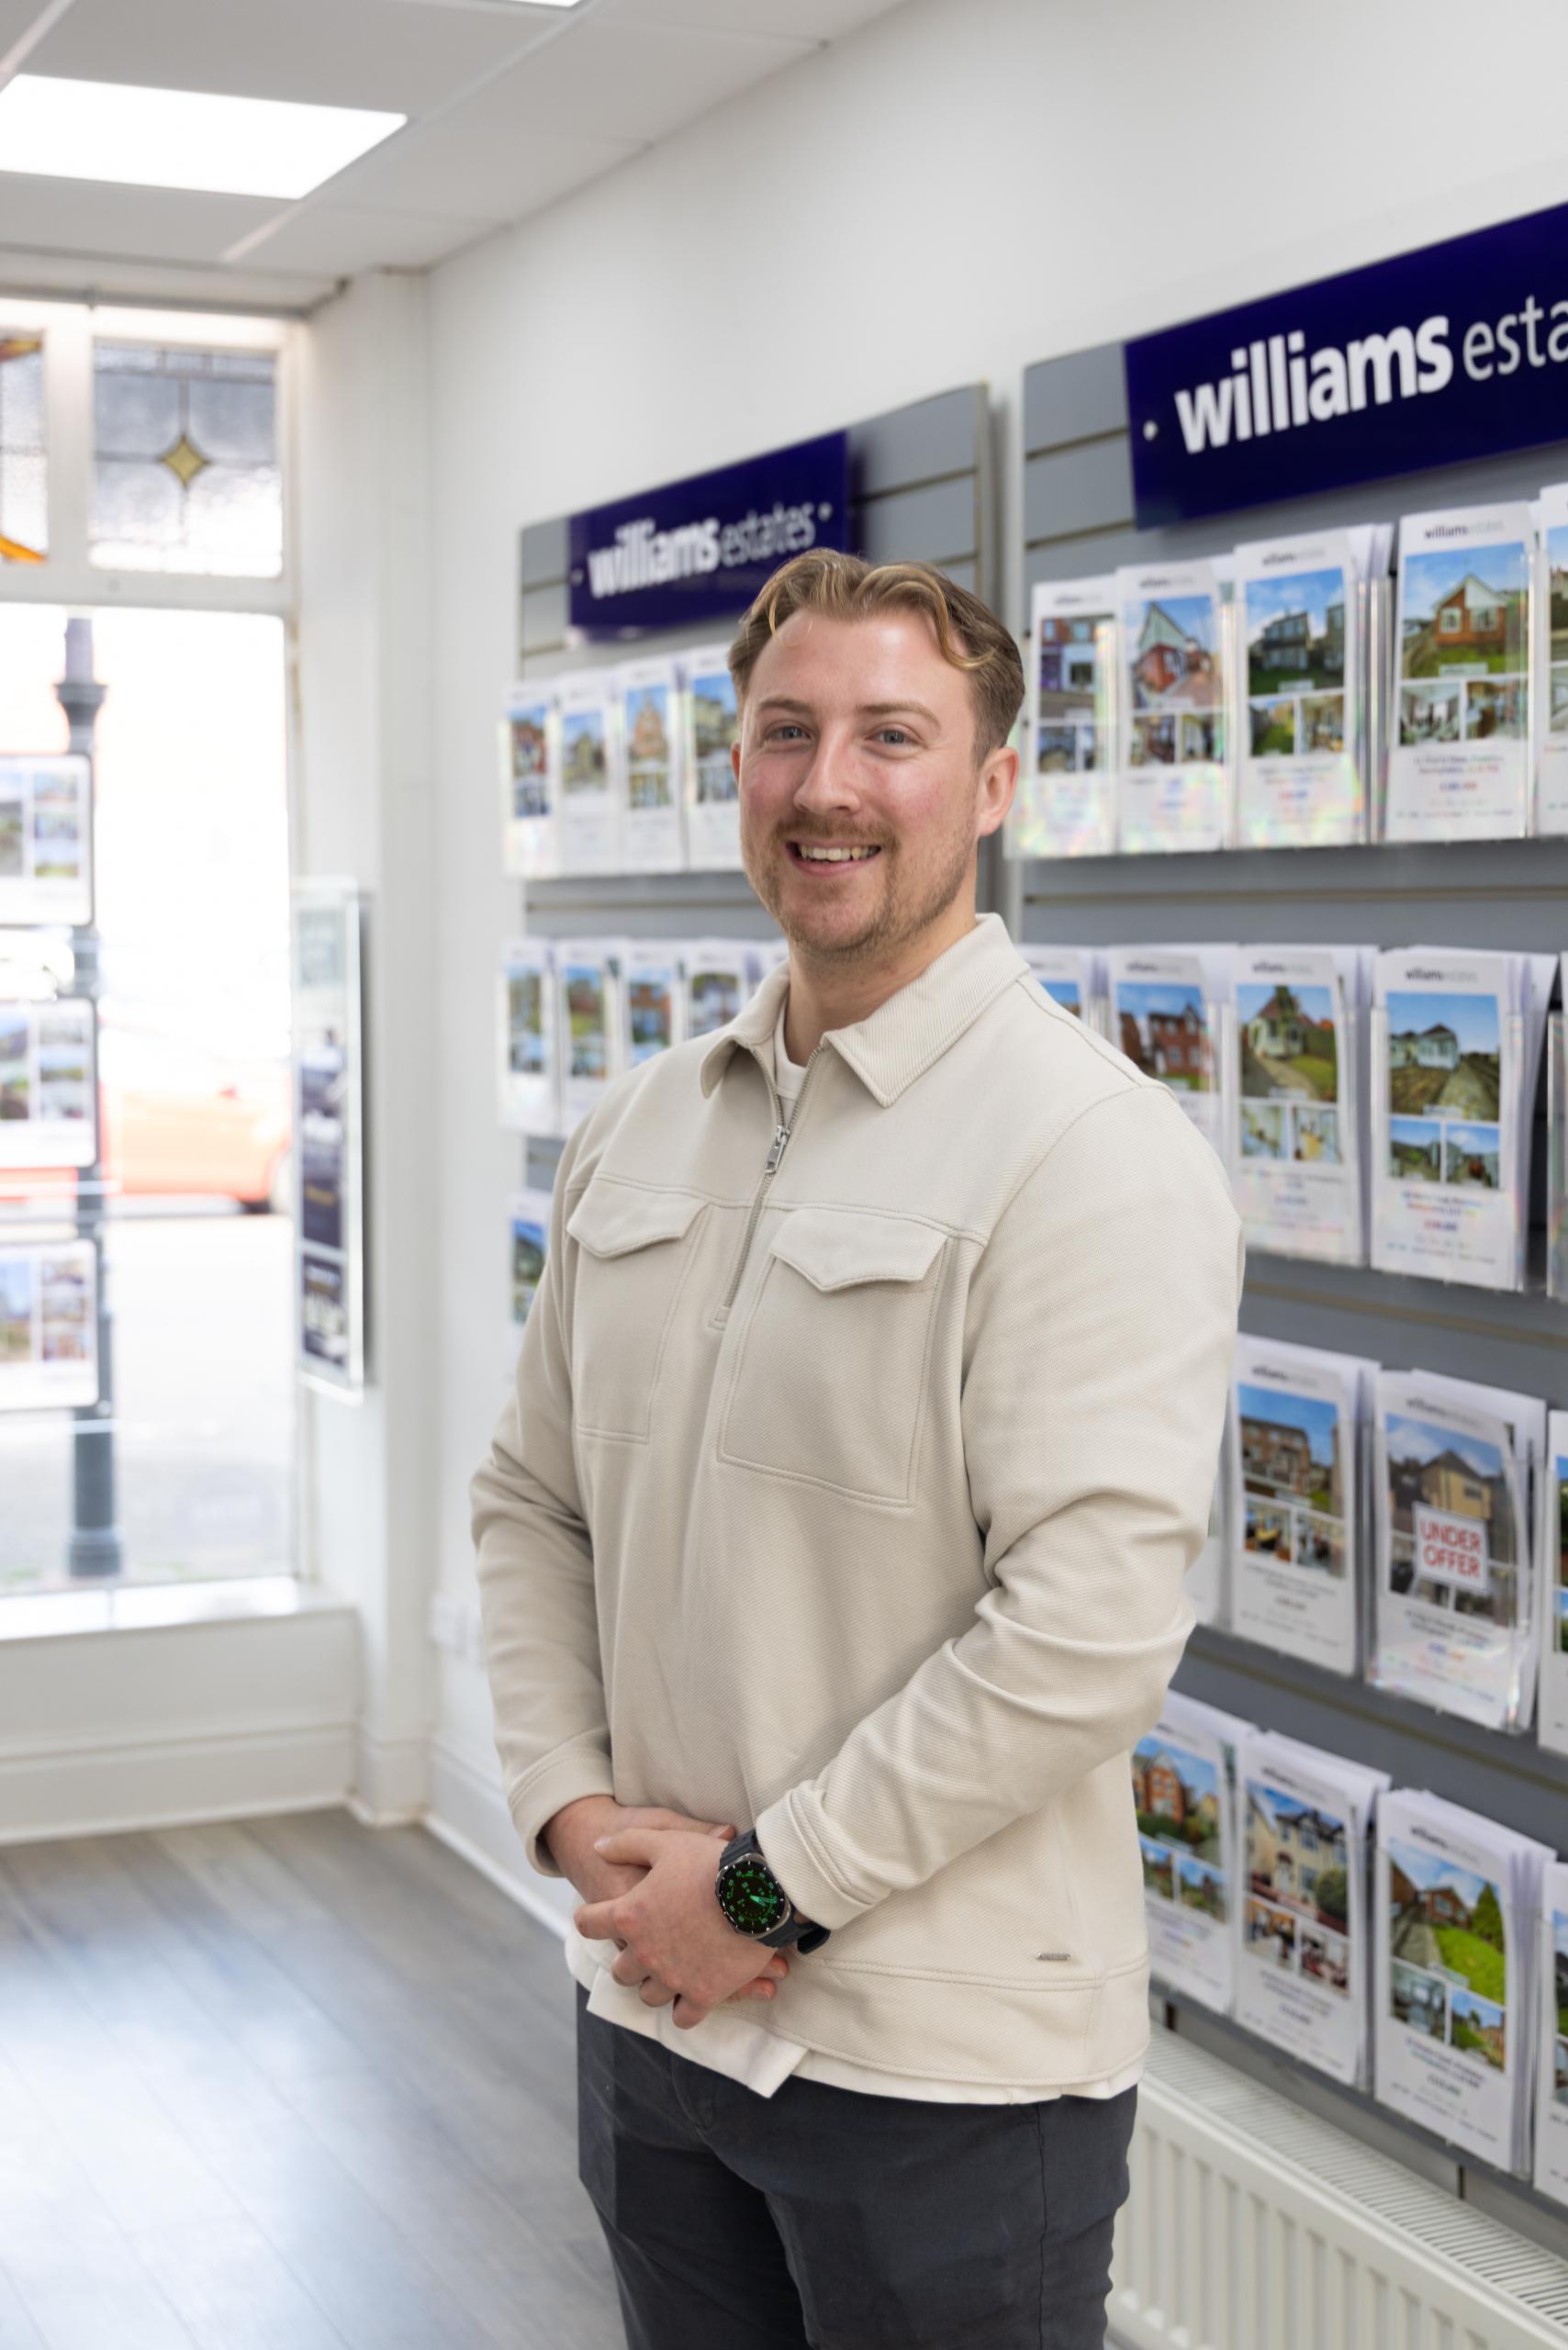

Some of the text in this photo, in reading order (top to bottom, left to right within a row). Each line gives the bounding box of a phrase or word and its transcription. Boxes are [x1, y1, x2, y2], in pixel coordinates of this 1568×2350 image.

[1174, 315, 1454, 454] williams
[587, 501, 815, 599] williams estates
[1420, 1518, 1481, 1552] UNDER
[1424, 1544, 1481, 1578] OFFER
